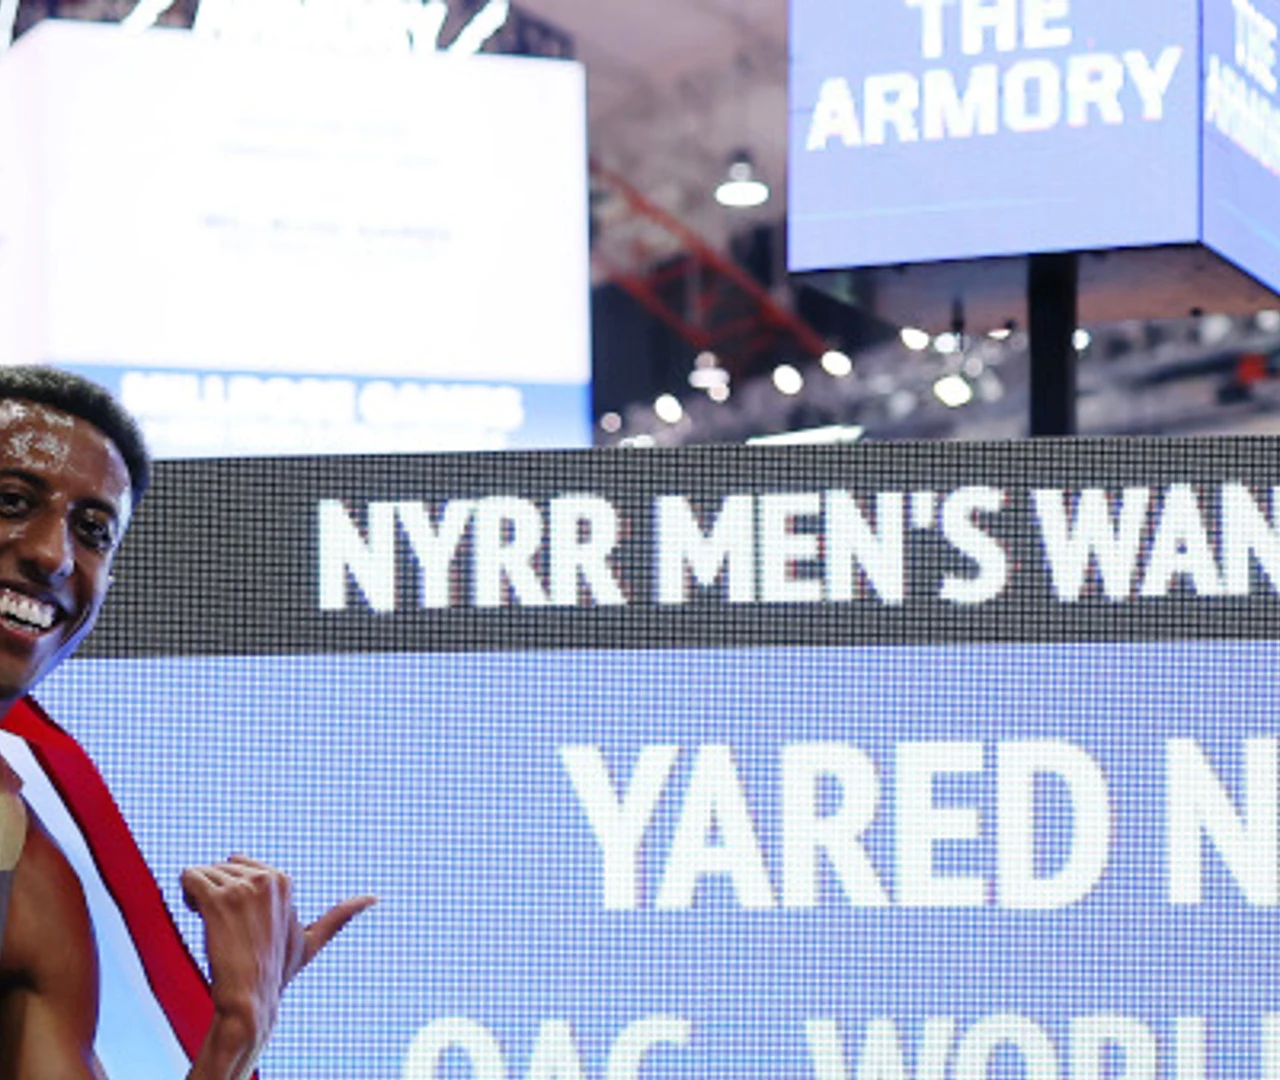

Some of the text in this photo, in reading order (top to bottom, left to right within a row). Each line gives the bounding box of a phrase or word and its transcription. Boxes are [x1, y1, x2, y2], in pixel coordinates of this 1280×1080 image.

[904, 0, 1072, 58] THE
[806, 46, 1182, 151] ARMORY
[318, 491, 628, 614] NYRR
[656, 483, 1010, 606] MEN'S
[559, 738, 1112, 912] YARED
